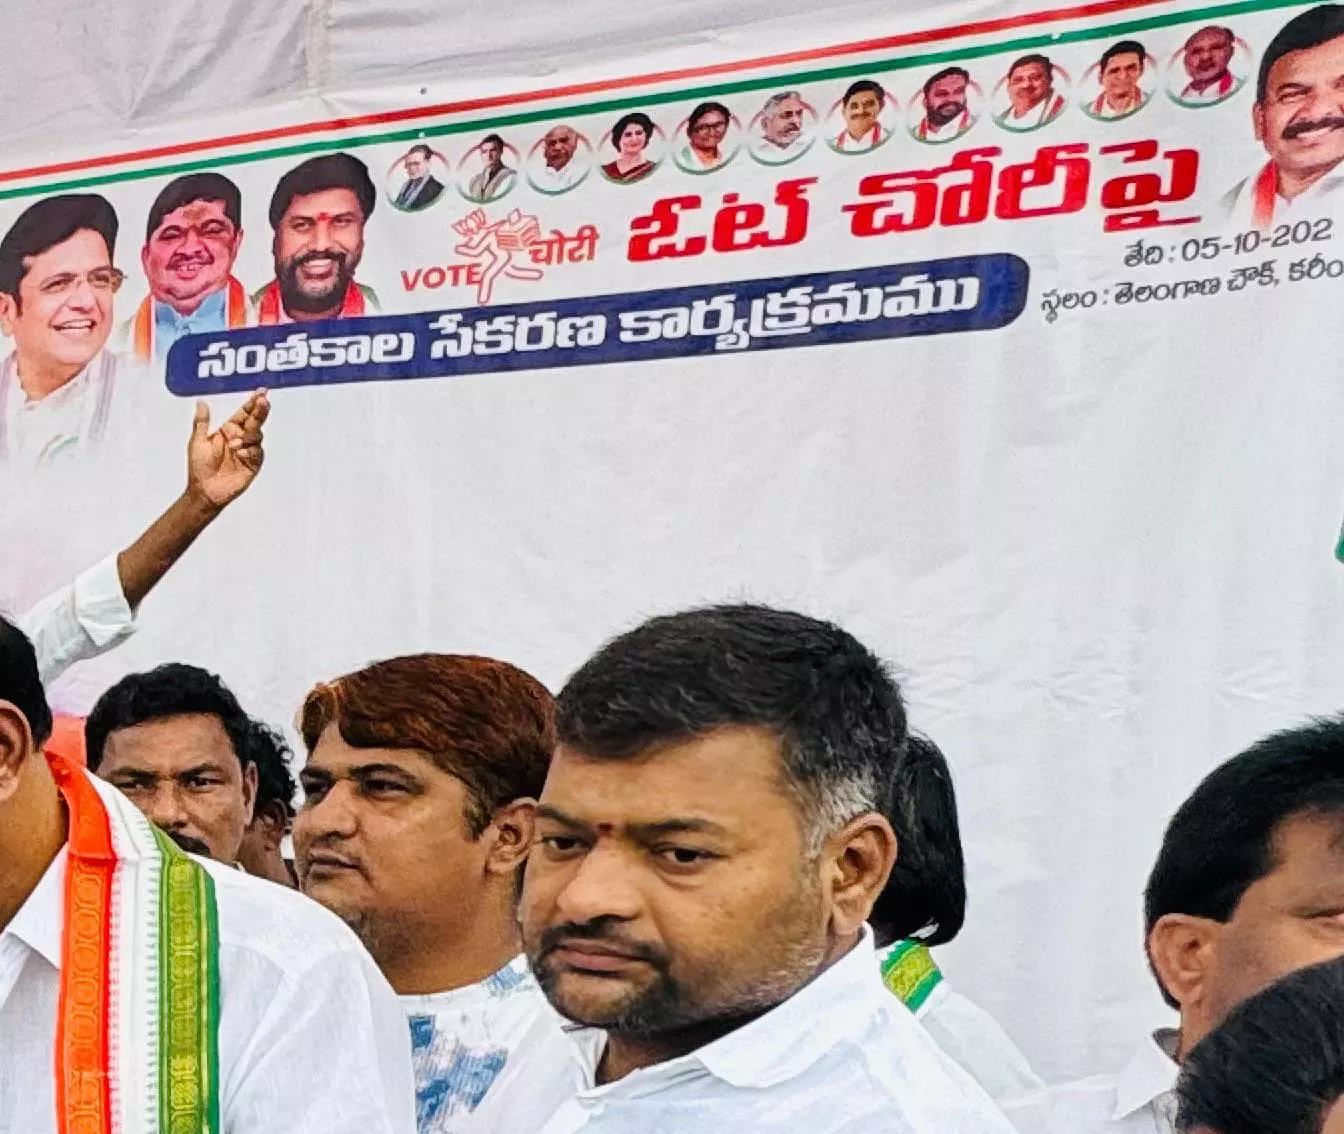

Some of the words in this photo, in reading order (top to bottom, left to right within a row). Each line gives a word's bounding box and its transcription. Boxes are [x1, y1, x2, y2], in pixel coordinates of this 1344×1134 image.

[626, 176, 819, 262] ఓట్
[842, 138, 1203, 238] చోరీపై
[1181, 217, 1334, 263] 05-10-202
[400, 263, 482, 292] VOTE
[1114, 275, 1222, 305] తెలంగాణ
[197, 331, 416, 378] సంతకాల
[429, 312, 608, 360] సేకరణ
[618, 273, 980, 351] కార్యక్రమము
